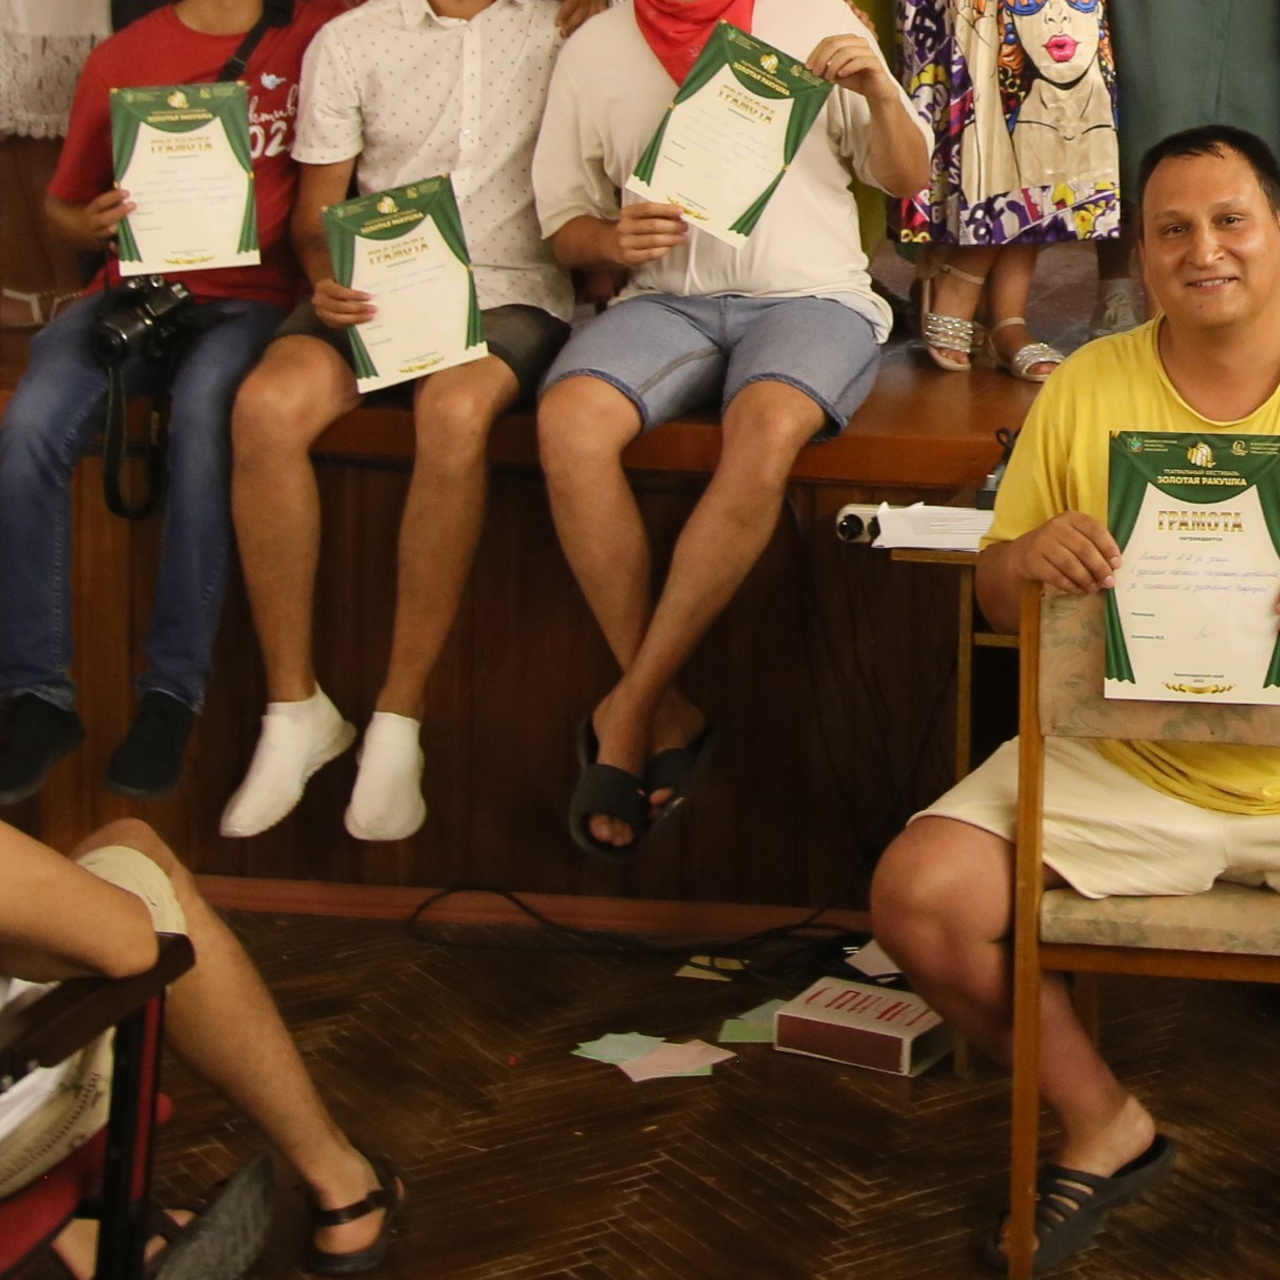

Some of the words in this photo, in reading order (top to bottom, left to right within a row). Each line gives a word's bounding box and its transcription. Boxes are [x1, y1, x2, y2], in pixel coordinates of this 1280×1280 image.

[150, 136, 213, 153] ГРАМОТА
[1157, 476, 1200, 485] ЗОЛОТАЯ
[1201, 477, 1247, 487] РАКУШКА
[1157, 511, 1245, 532] ГРАМОТА
